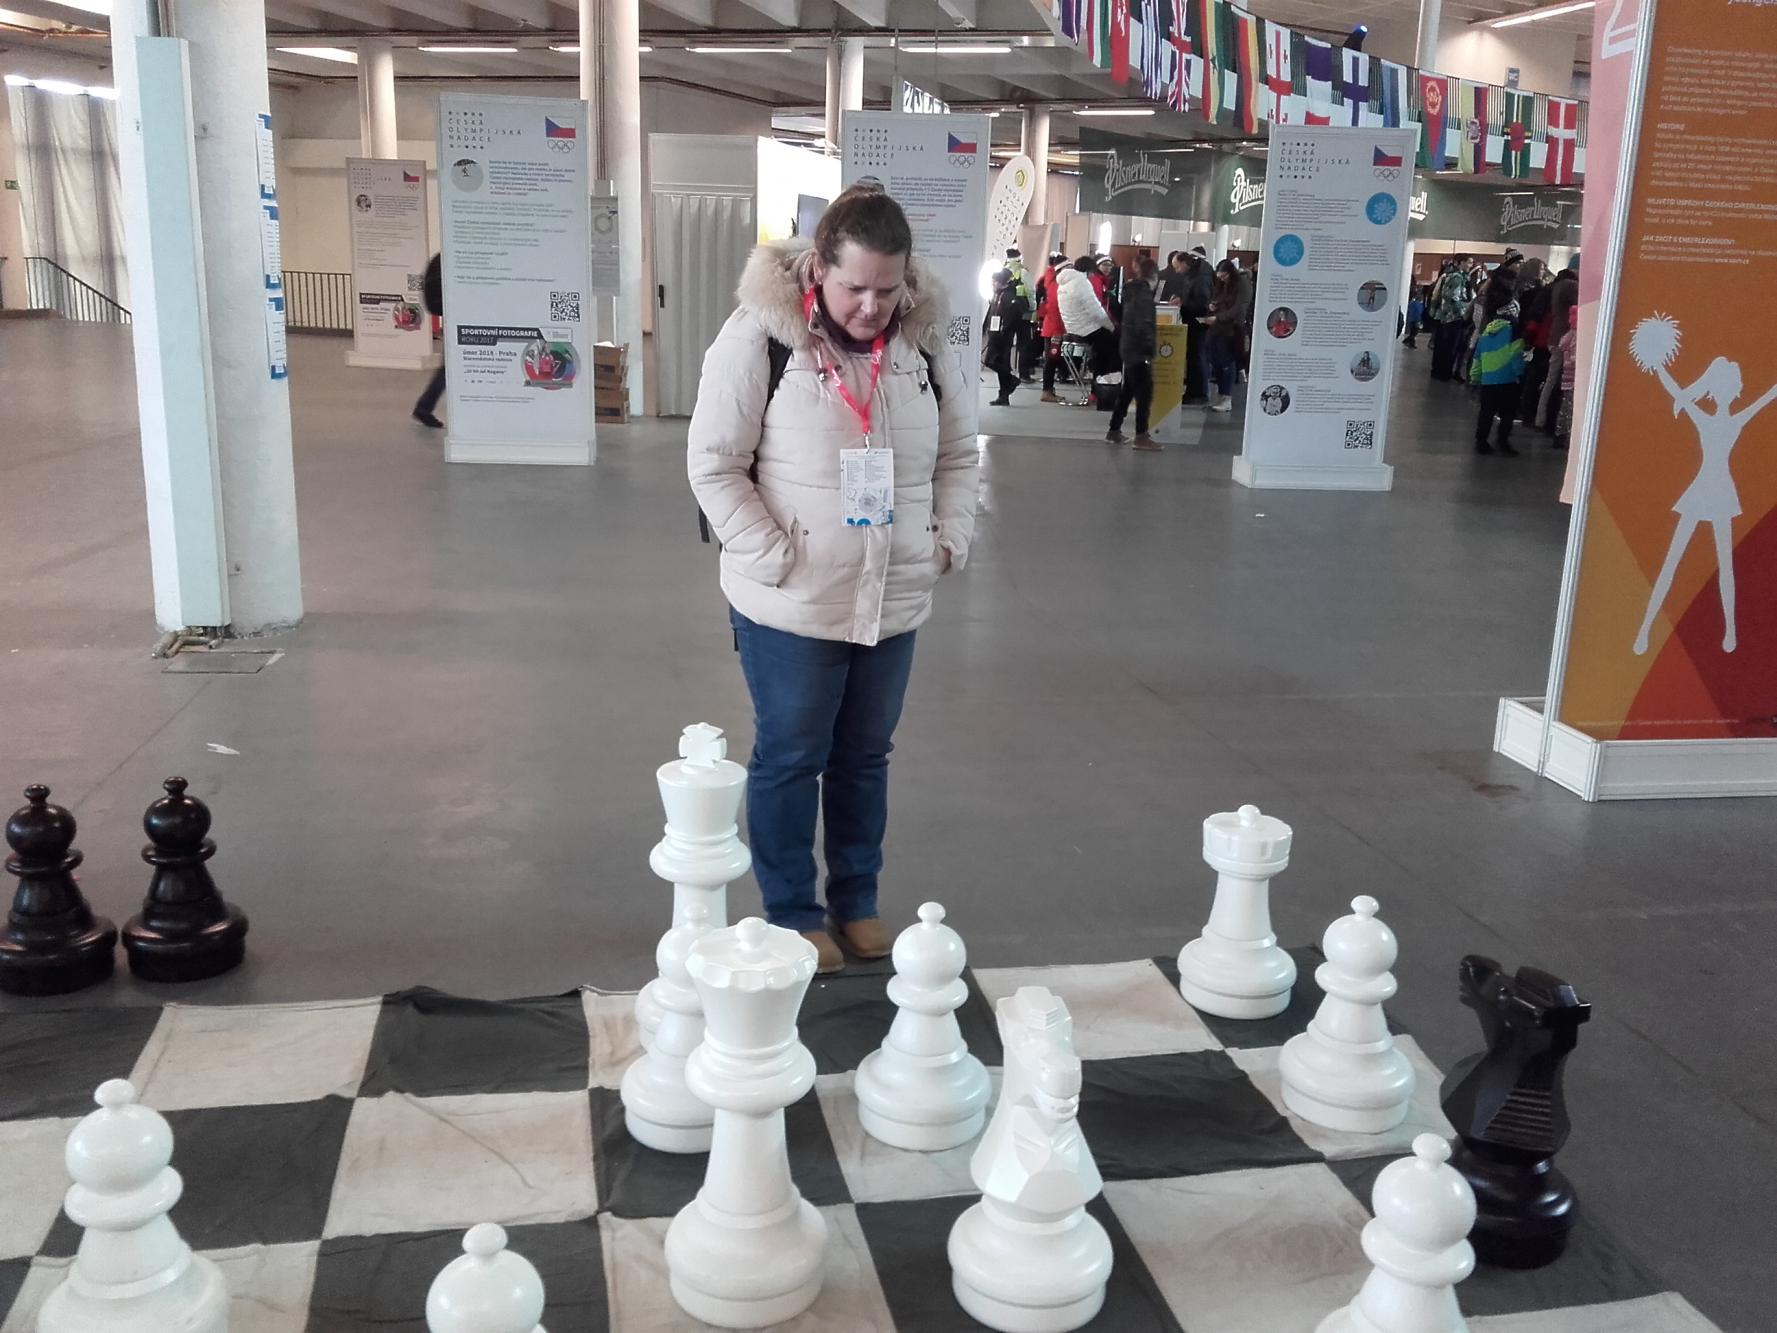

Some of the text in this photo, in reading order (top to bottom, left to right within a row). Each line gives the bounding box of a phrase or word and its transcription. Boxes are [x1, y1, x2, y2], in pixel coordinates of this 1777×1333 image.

[448, 134, 492, 143] NADACE
[853, 151, 895, 160] NADACE
[1279, 165, 1320, 173] NADACE
[1104, 148, 1171, 202] Pilsner Urquell
[1230, 167, 1264, 214] Pilsne
[1500, 196, 1562, 234] Pilsner Urquell
[461, 328, 498, 336] SPORTOVNÍ
